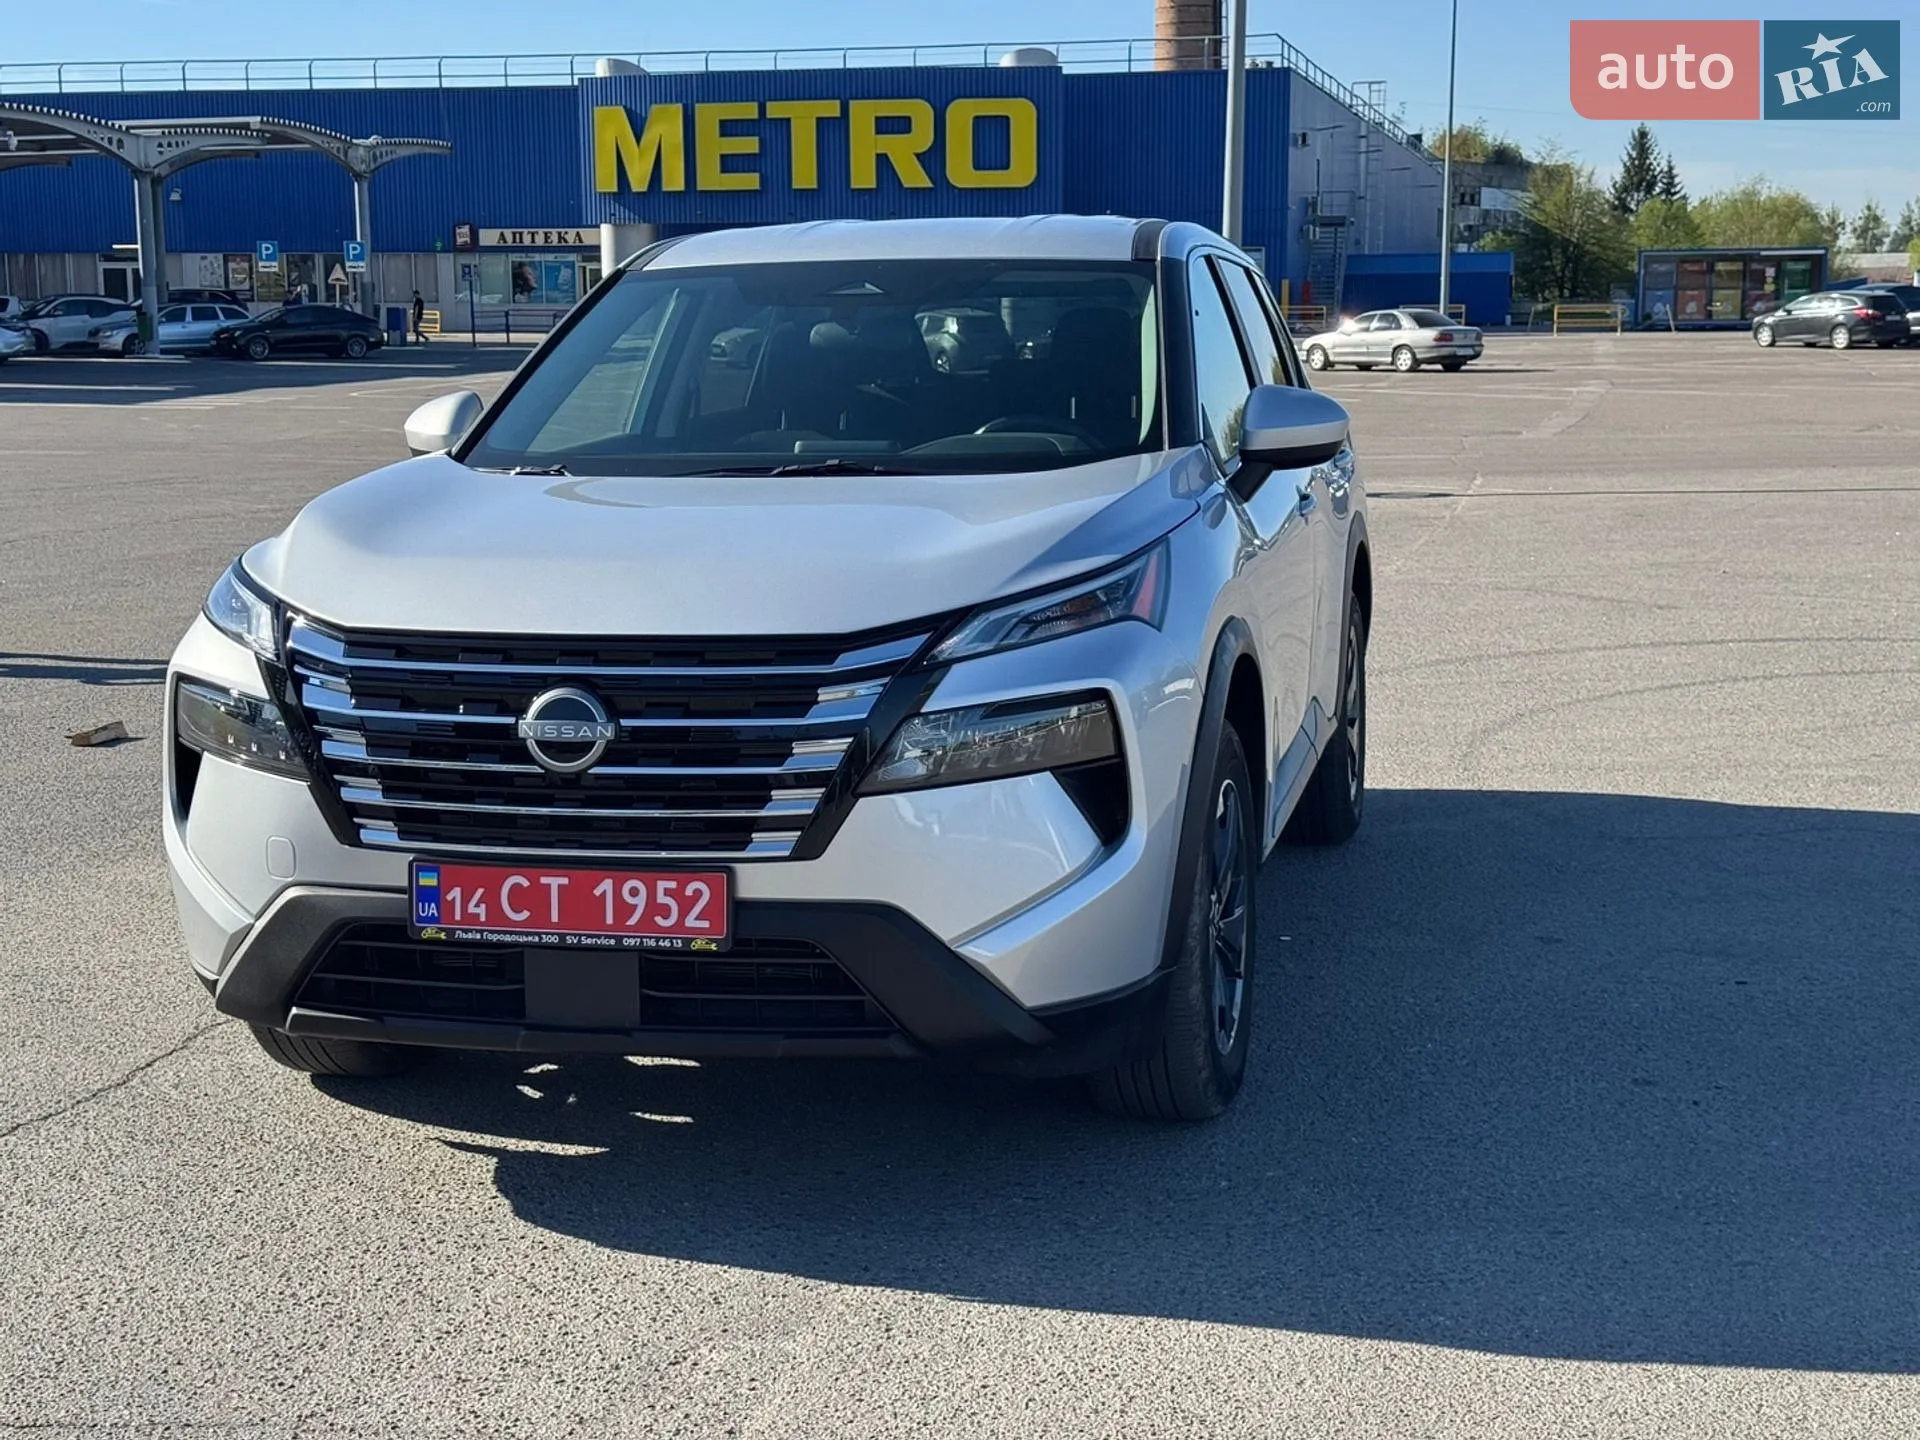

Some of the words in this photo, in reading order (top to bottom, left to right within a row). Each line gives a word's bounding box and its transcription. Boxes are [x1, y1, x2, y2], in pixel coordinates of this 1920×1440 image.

[594, 98, 1037, 192] METRO
[497, 231, 584, 244] АПТЕКА
[261, 243, 273, 260] P
[349, 243, 361, 260] P
[520, 725, 611, 738] NISSAN
[418, 902, 438, 917] UA
[445, 886, 487, 921] 14
[593, 878, 711, 928] 1952
[454, 930, 481, 940] Львів
[483, 932, 539, 943] Городоцька
[540, 934, 559, 943] 300
[566, 935, 579, 944] SV
[581, 936, 616, 946] Service
[622, 937, 641, 946] 097
[642, 938, 656, 947] 116
[658, 938, 671, 947] 46
[672, 938, 683, 948] 13
